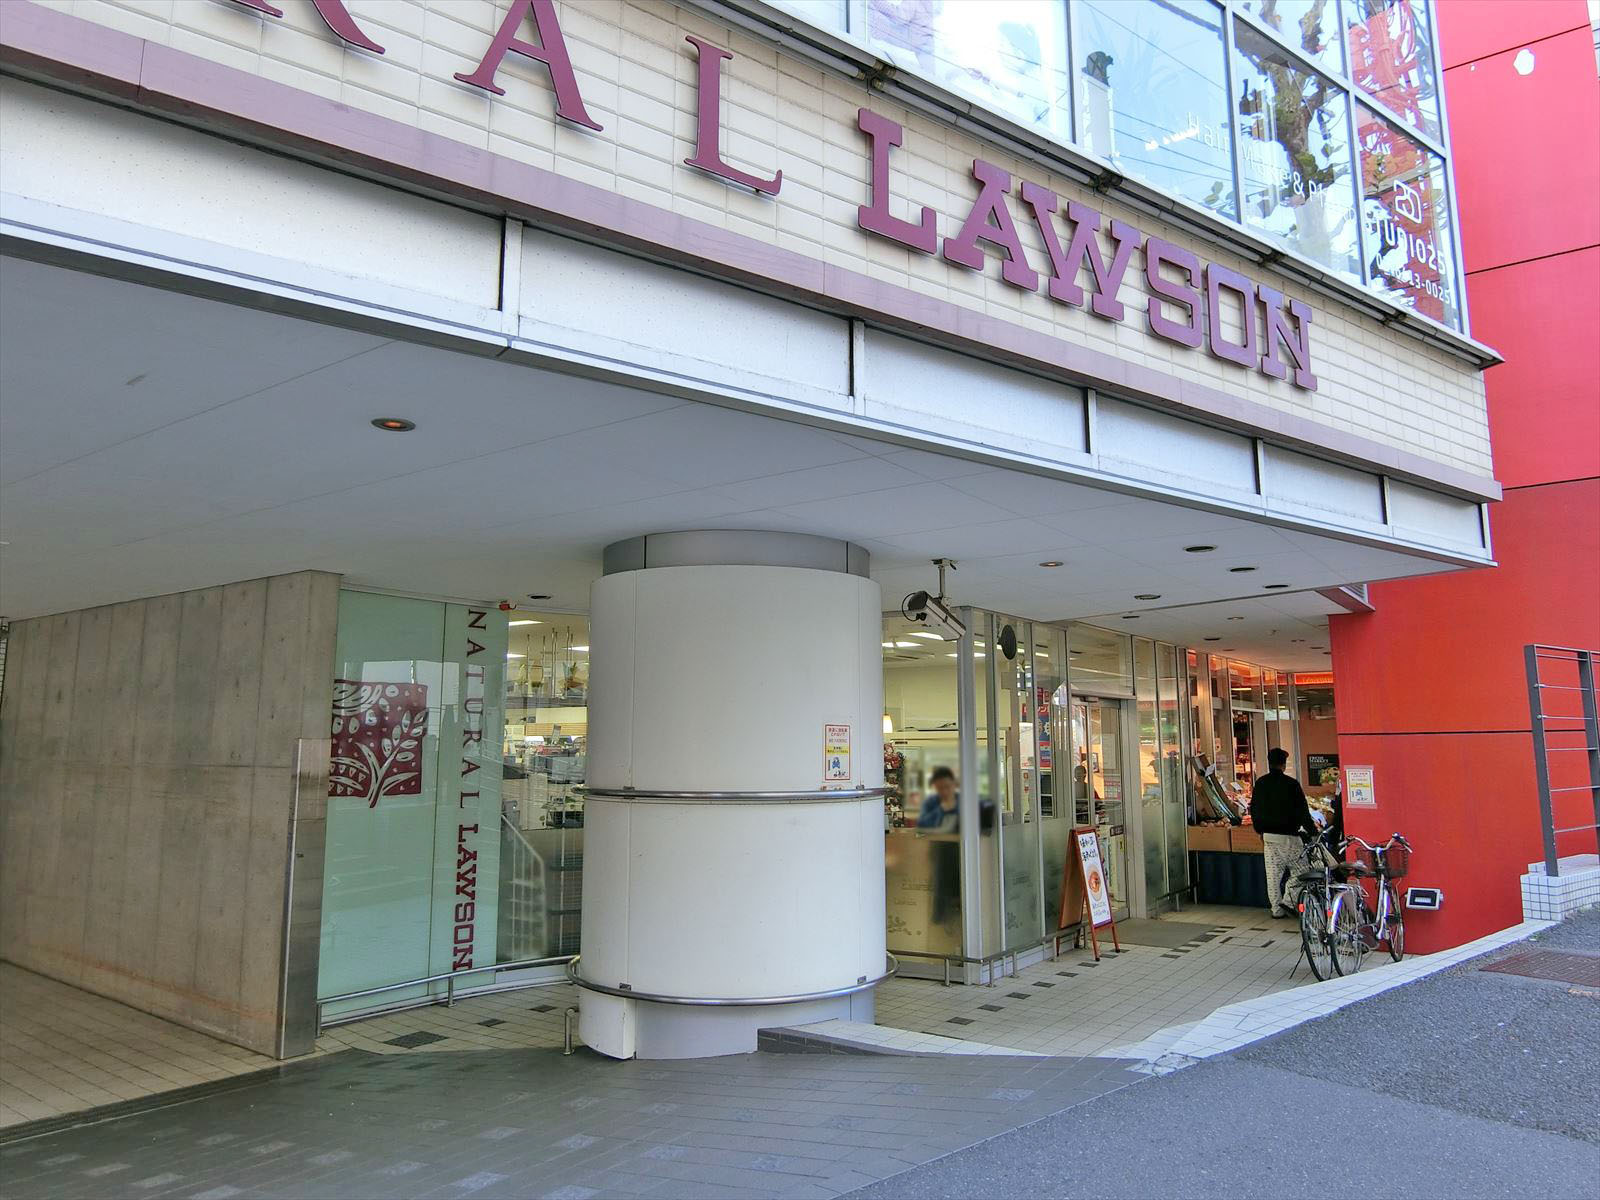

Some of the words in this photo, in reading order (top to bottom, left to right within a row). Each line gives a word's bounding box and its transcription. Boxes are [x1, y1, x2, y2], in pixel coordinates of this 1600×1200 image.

[229, 0, 784, 197] AL
[857, 107, 1319, 393] LAWSON
[459, 608, 488, 809] NATURAL
[452, 823, 479, 971] LAWSON
